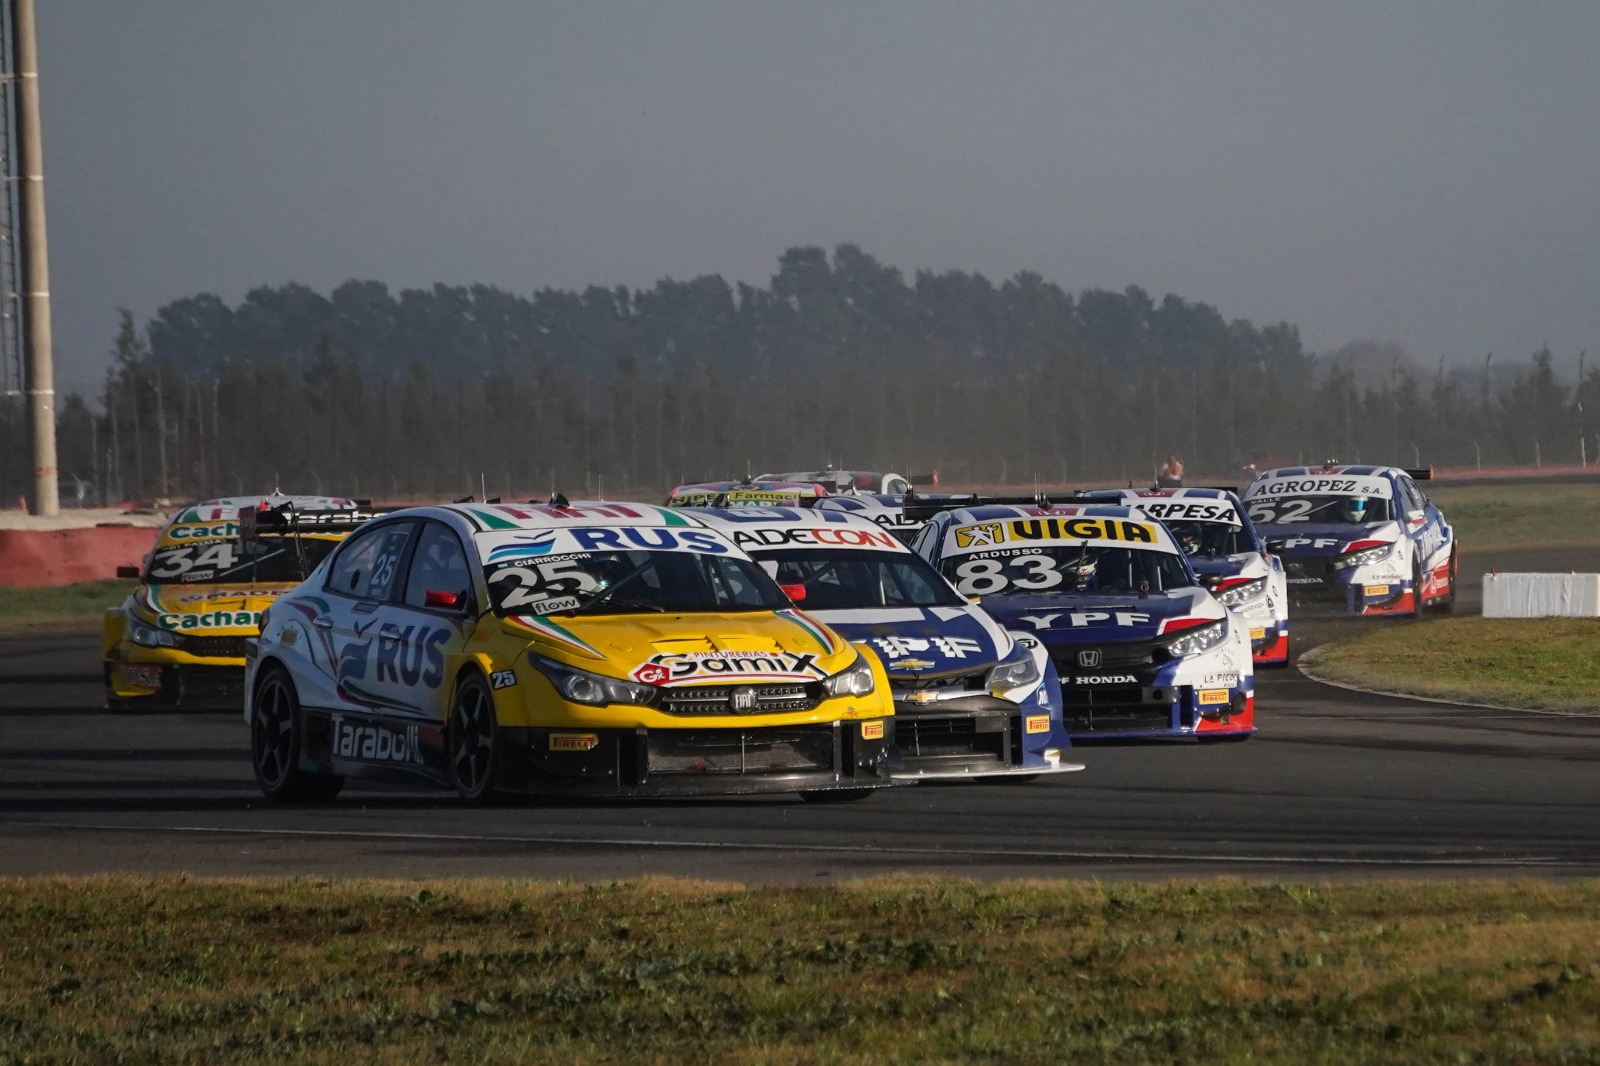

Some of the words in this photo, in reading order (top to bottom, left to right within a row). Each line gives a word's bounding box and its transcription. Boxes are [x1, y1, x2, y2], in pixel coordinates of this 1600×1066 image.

[1253, 481, 1357, 496] AGROPEZ
[1361, 486, 1383, 495] S.A.
[1248, 500, 1313, 524] 52
[568, 529, 729, 553] RUS
[734, 528, 897, 549] ADECON
[151, 543, 240, 578] 34
[514, 553, 591, 567] CIARROCCHI
[968, 548, 1042, 560] ARDUSSO
[370, 553, 398, 586] 25
[957, 555, 1063, 596] 83
[488, 560, 598, 609] 25
[536, 600, 576, 613] flow
[1020, 612, 1150, 630] YPF
[376, 623, 451, 689] RUS
[694, 651, 768, 660] PINTURERIAS
[493, 671, 516, 690] 25
[1076, 675, 1138, 684] HONDA
[735, 695, 751, 708] FIAT
[1202, 691, 1227, 701] PIRELLI
